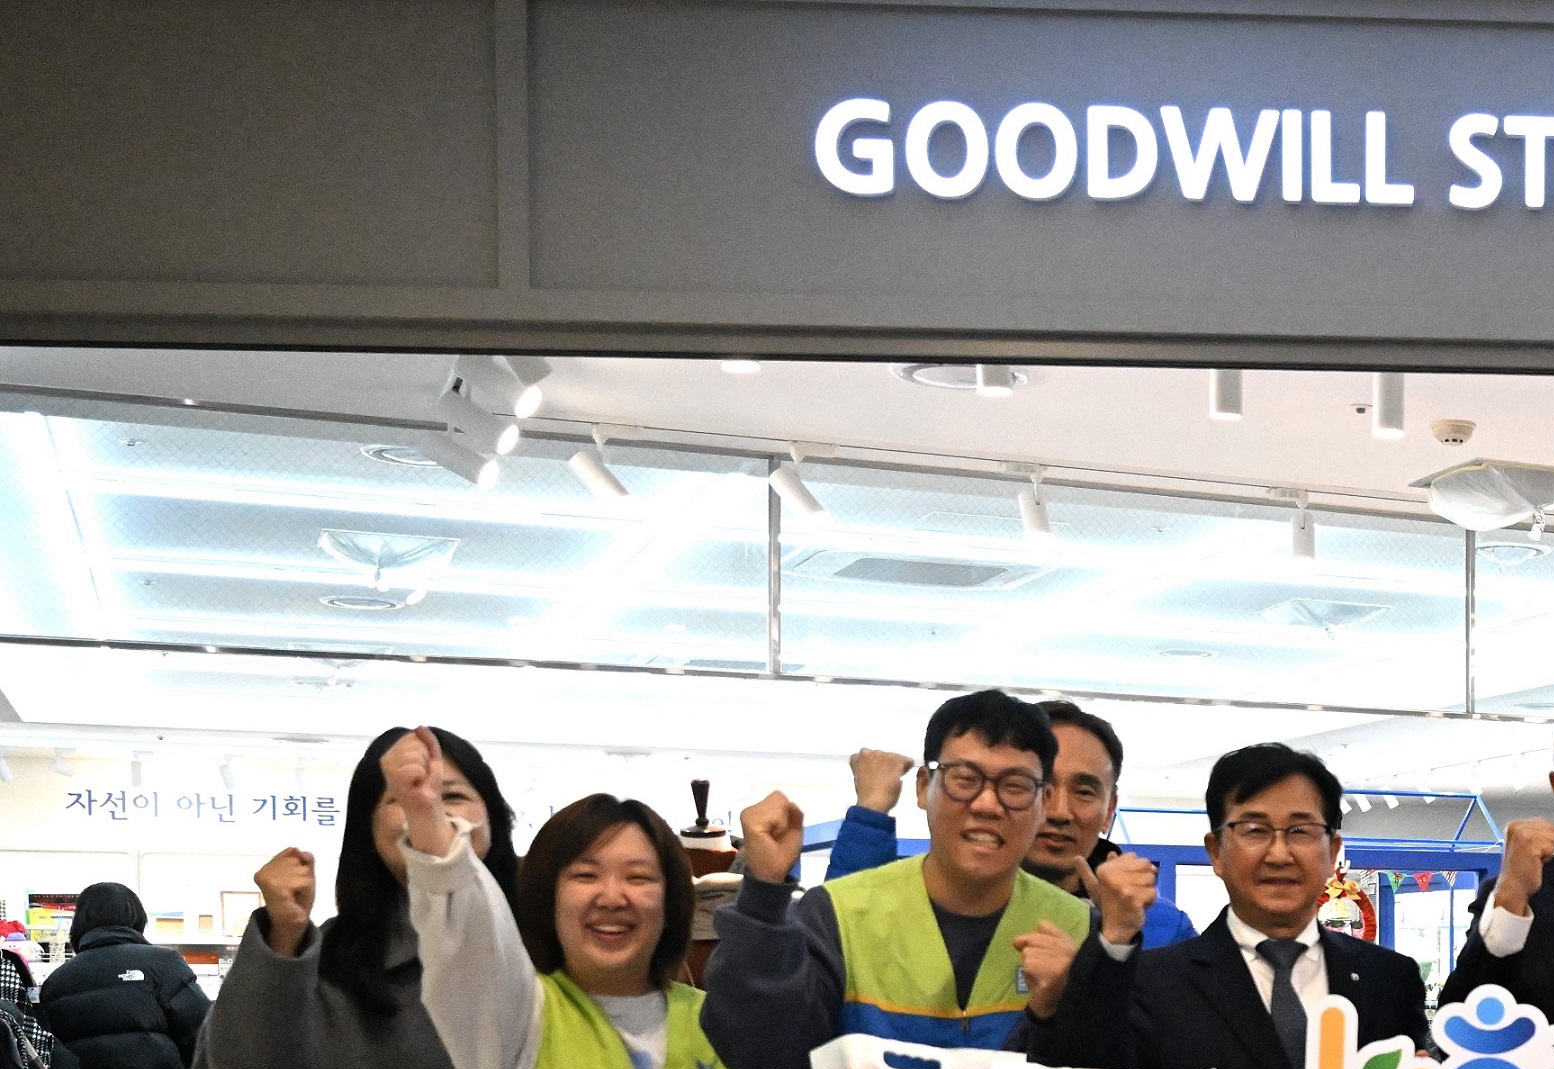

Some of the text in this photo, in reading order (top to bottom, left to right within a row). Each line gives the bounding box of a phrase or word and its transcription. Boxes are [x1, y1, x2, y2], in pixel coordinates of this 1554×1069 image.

[813, 98, 1415, 208] GOODWILL
[65, 789, 340, 826] 자선이 아닌 기회를
